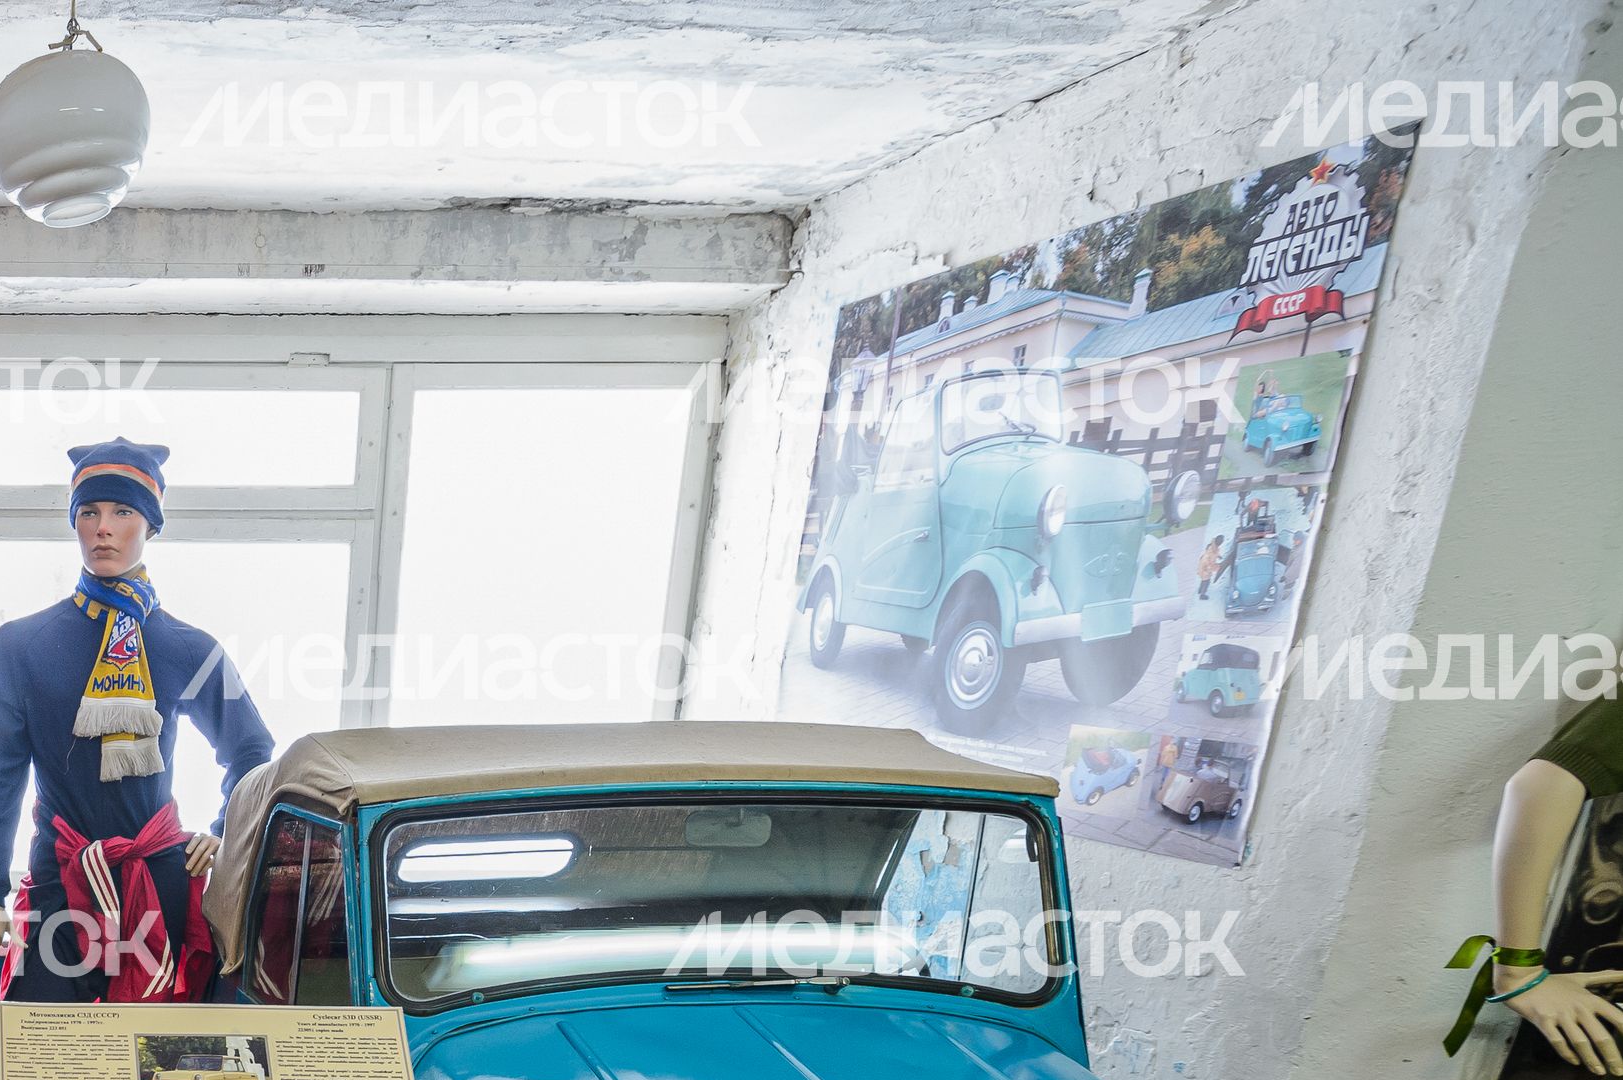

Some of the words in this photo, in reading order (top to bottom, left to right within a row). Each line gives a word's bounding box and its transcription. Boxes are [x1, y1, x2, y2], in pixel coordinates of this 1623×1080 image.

[1283, 191, 1339, 236] АВТО
[1240, 208, 1370, 286] ЛЕГЕНДЫ
[1272, 292, 1306, 315] СССР
[312, 1013, 341, 1021] Cyclecar
